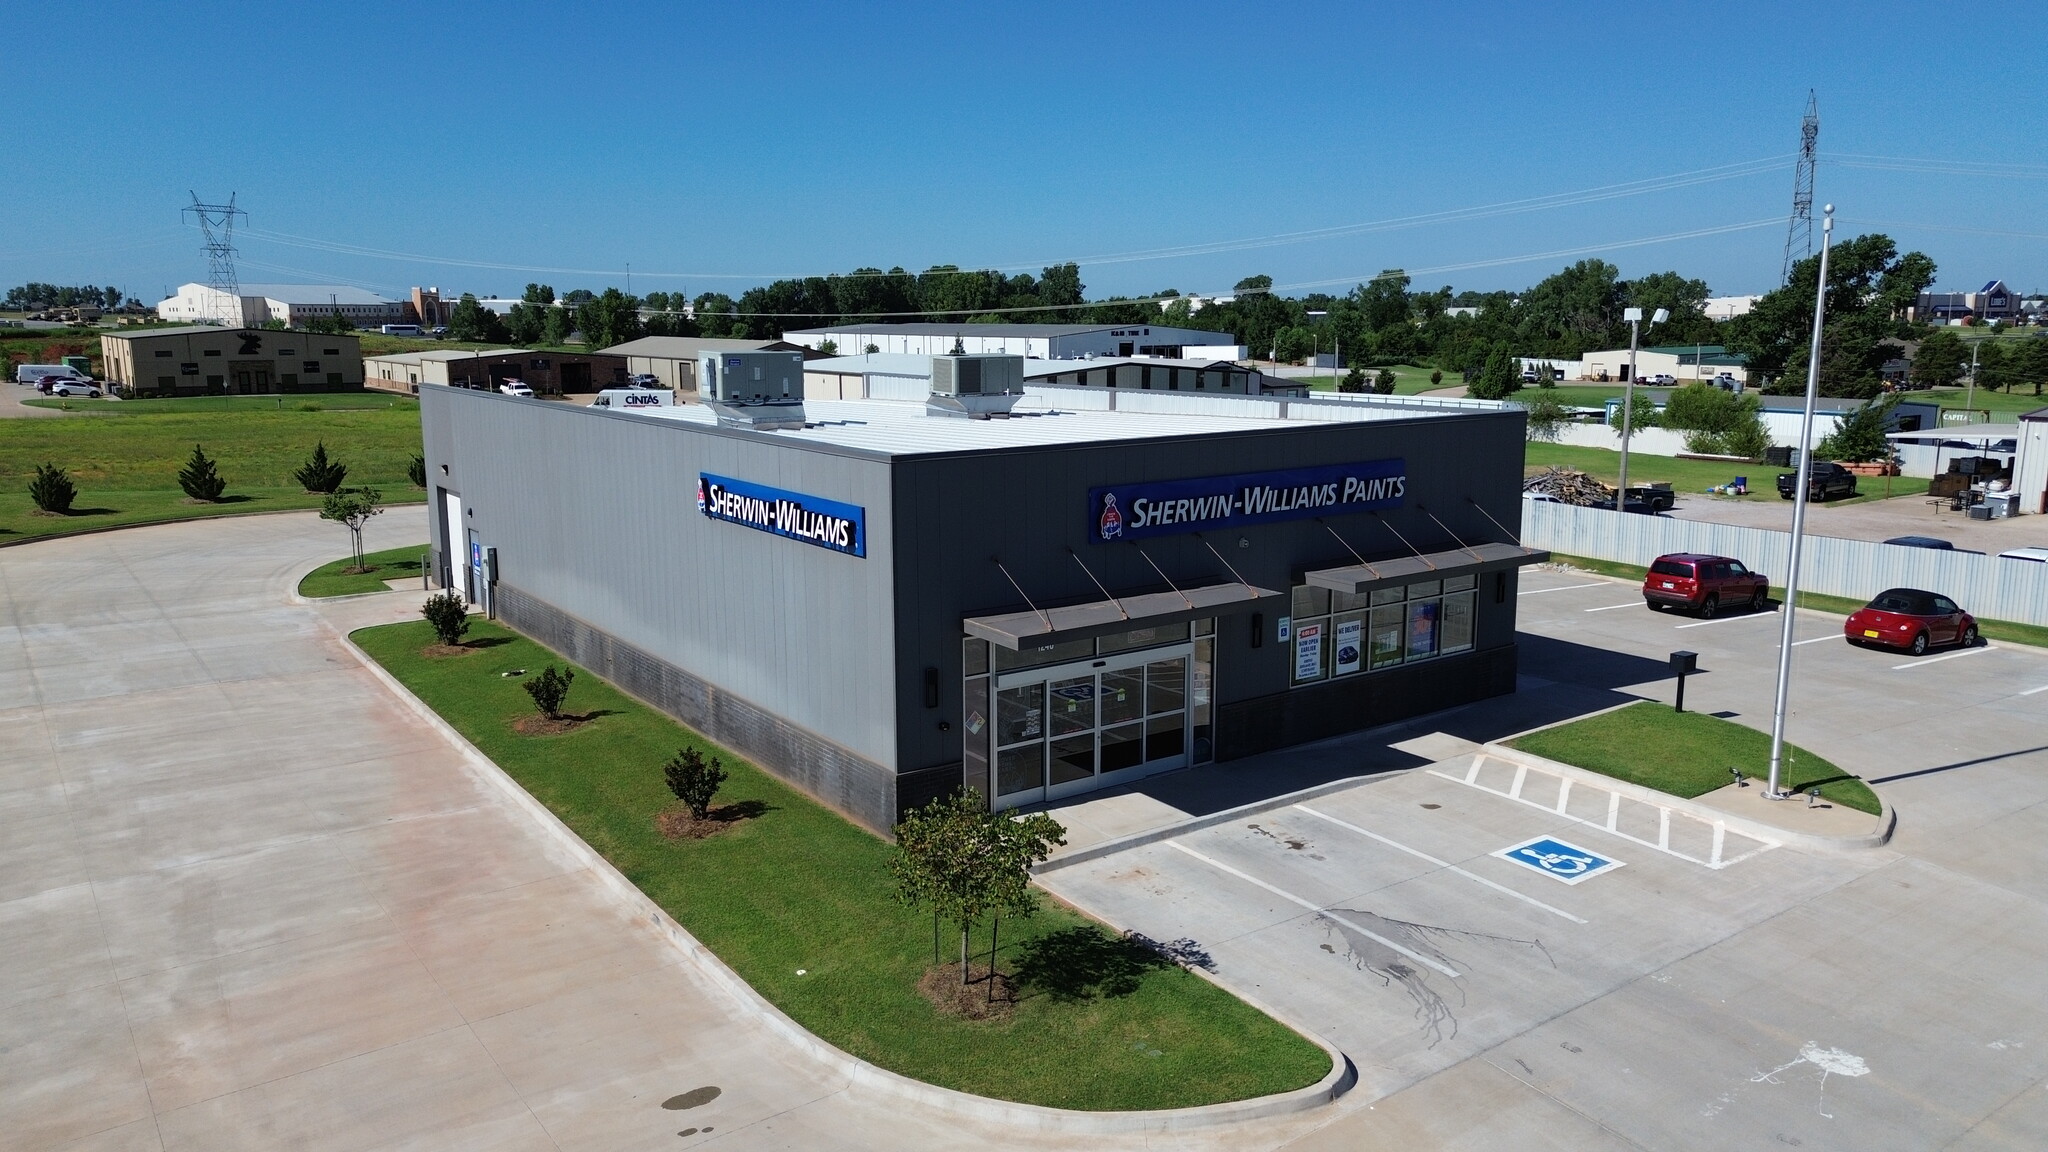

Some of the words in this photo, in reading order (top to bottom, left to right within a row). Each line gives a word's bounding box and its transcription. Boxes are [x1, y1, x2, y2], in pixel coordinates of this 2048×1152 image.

[709, 484, 849, 547] SHERWIN-WILLIAMS
[1130, 483, 1338, 529] SHERWIN-WILLIAMS
[1342, 475, 1406, 504] PAINTS
